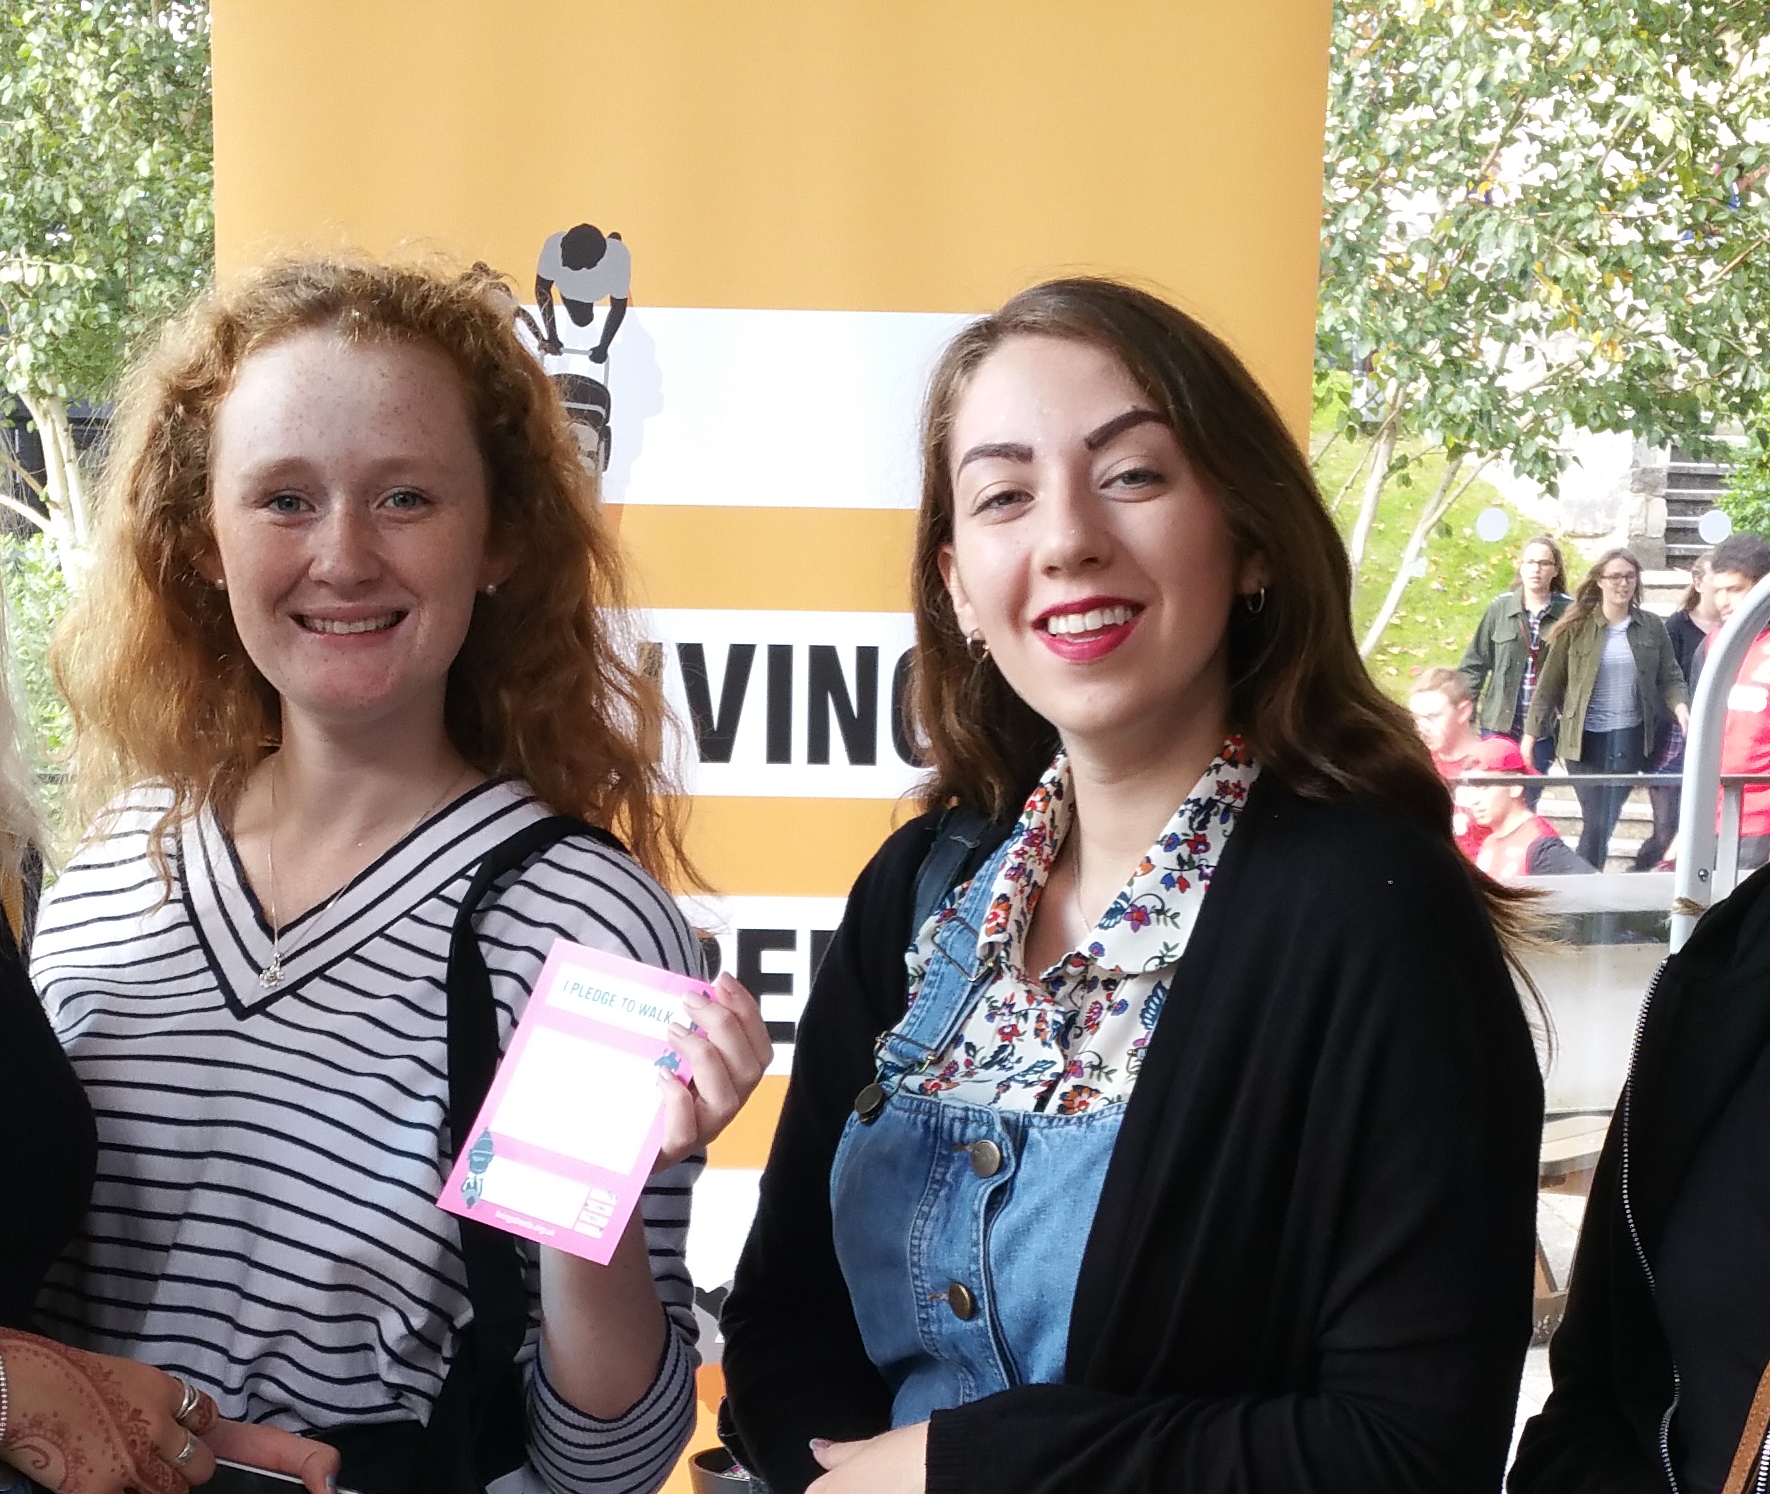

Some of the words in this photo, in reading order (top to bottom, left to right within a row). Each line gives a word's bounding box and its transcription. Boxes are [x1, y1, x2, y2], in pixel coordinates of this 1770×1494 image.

[562, 980, 569, 992] I
[570, 982, 617, 1008] PLEDGE
[620, 997, 636, 1013] TO
[638, 1003, 674, 1024] WALK
